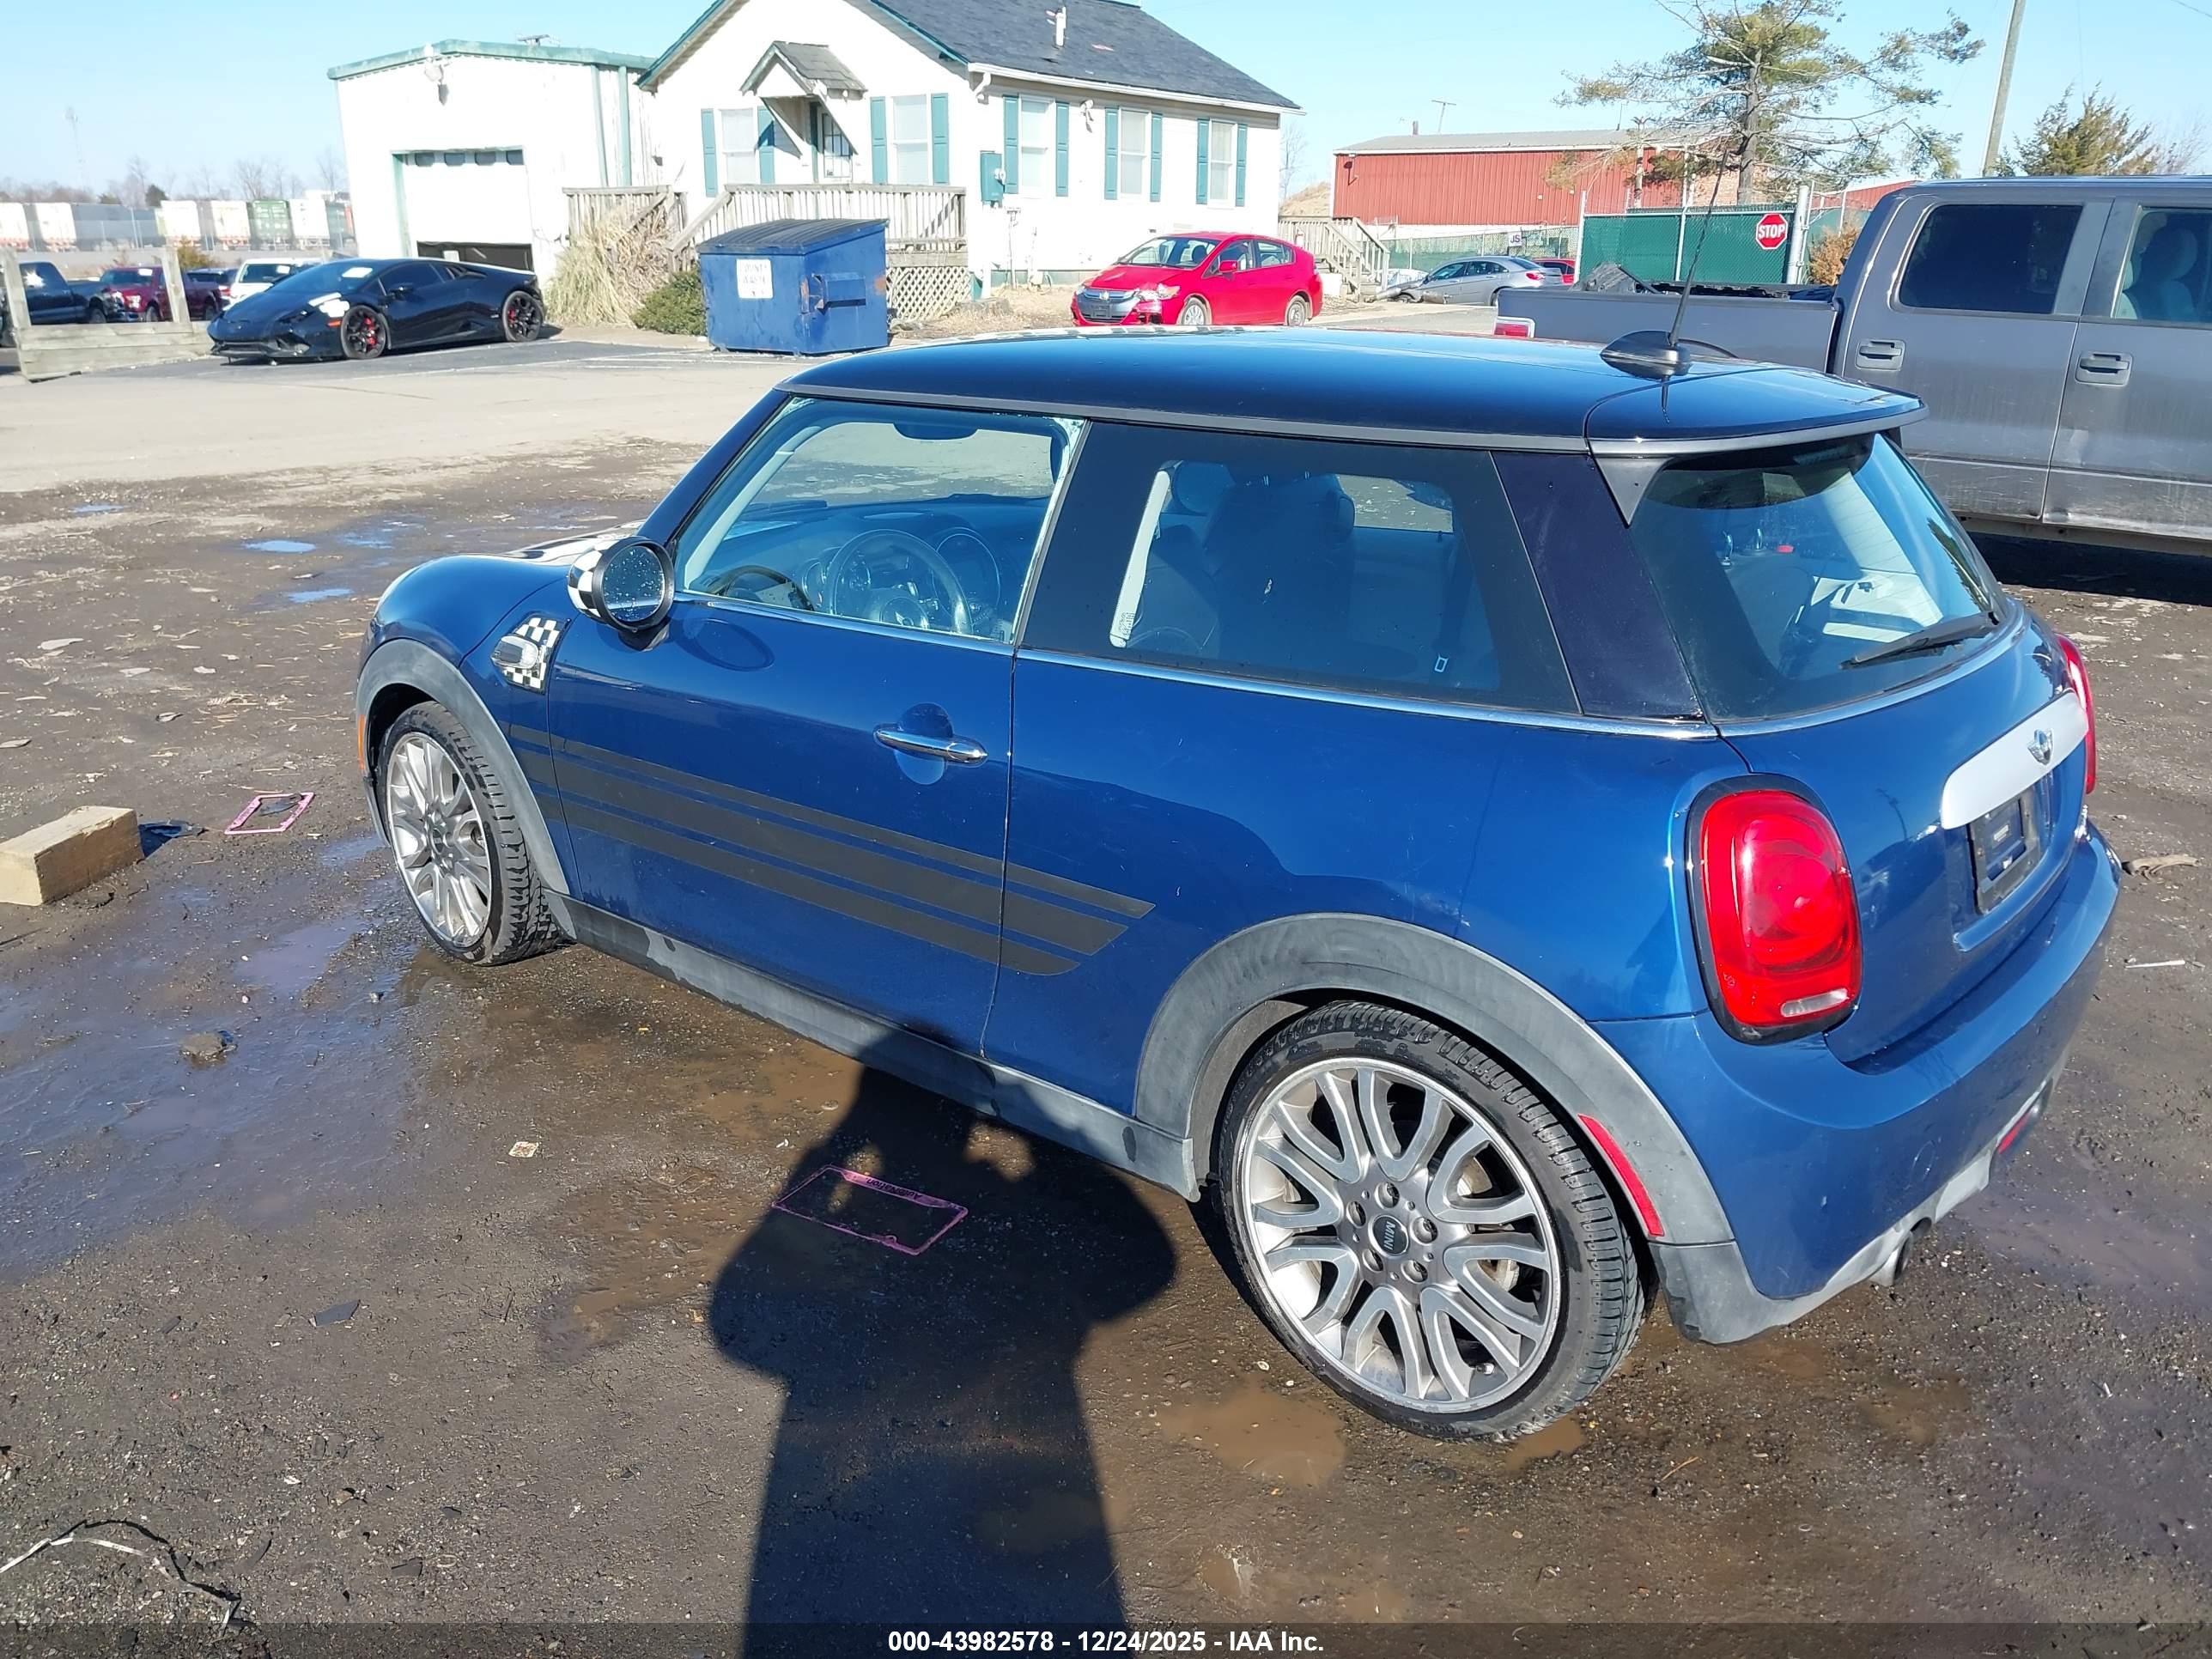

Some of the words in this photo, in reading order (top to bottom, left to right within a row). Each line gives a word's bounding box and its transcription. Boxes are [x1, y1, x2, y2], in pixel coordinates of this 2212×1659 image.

[1510, 234, 1521, 244] JS
[1758, 224, 1785, 240] STOP
[1382, 1220, 1396, 1251] MINI
